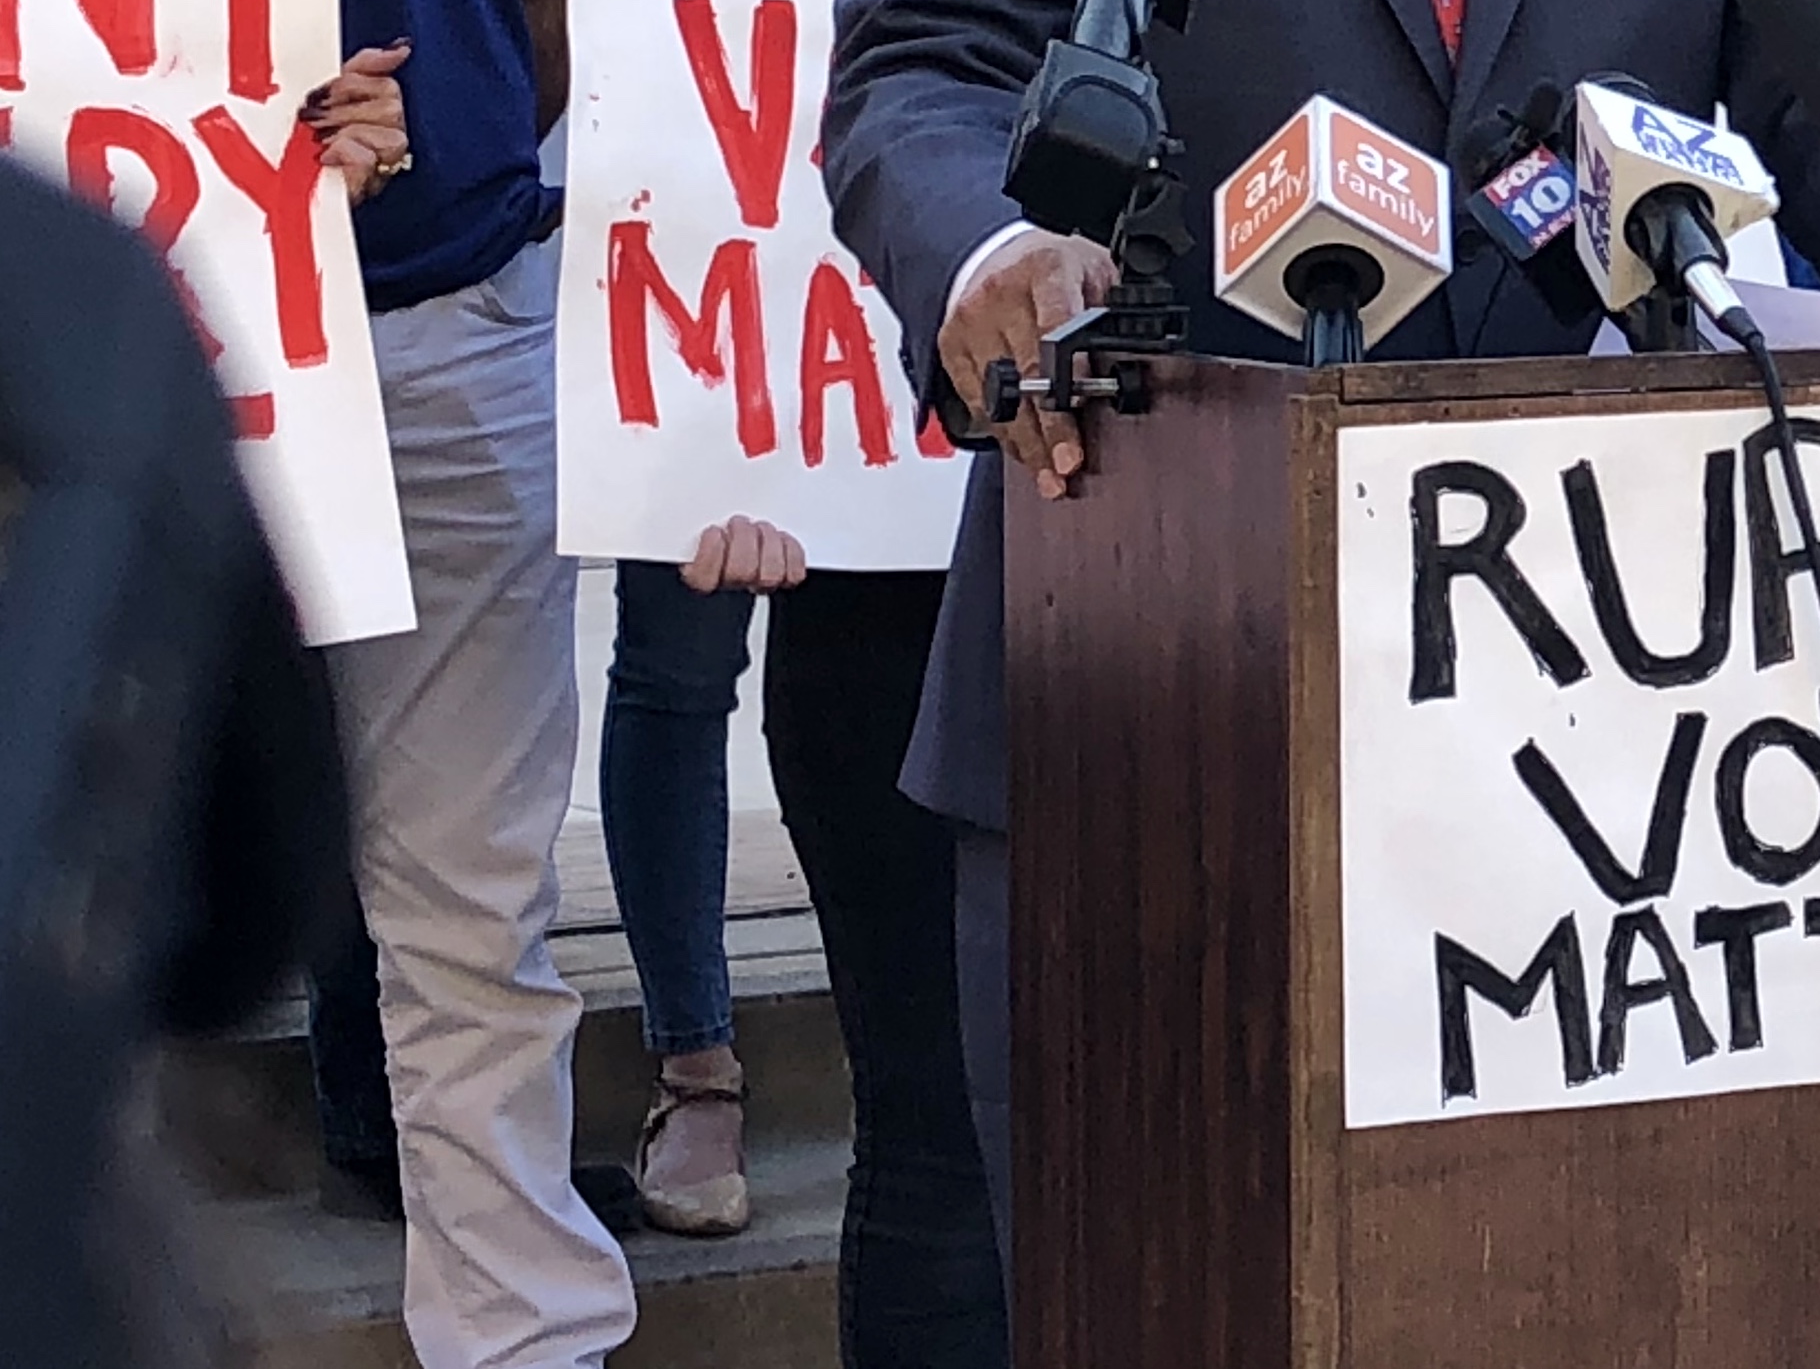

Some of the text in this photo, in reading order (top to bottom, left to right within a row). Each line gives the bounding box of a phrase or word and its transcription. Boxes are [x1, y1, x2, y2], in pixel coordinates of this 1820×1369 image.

[1244, 149, 1289, 209] az
[1355, 142, 1411, 194] az
[1491, 150, 1550, 201] FOX
[1229, 164, 1307, 252] family
[1337, 159, 1435, 238] family
[1510, 175, 1572, 228] 10
